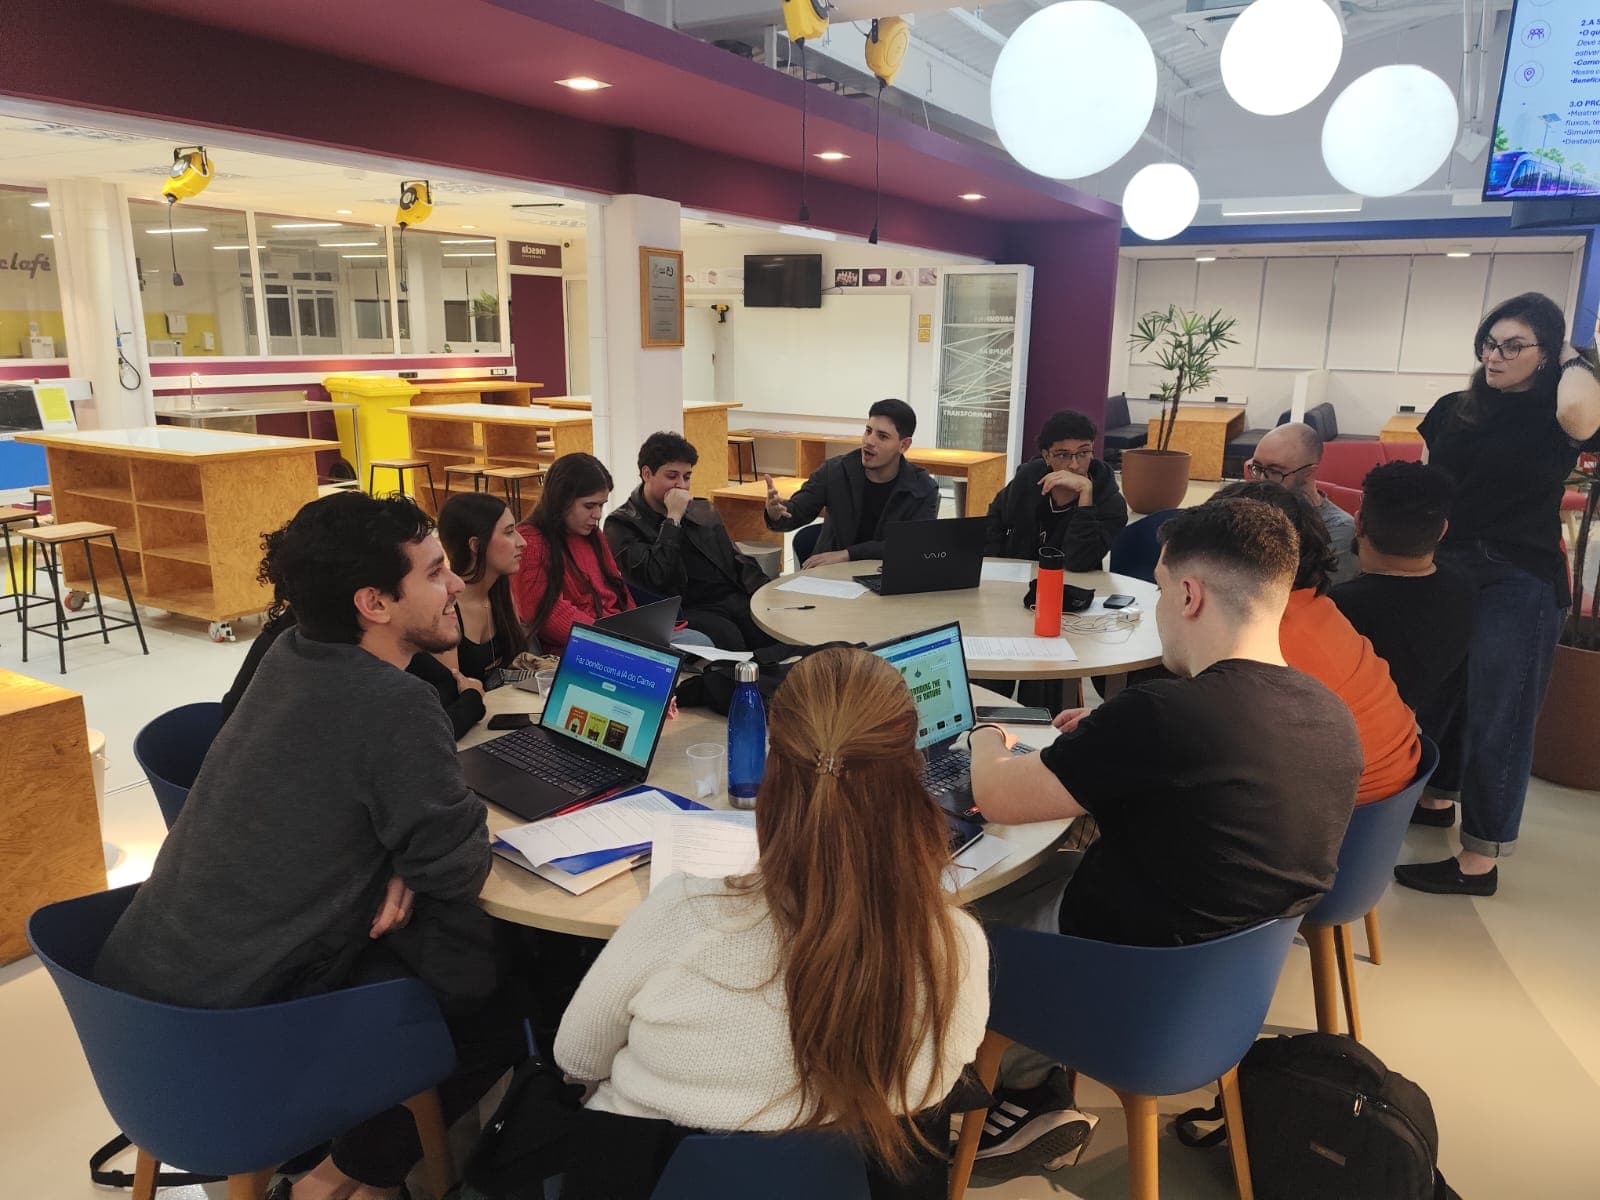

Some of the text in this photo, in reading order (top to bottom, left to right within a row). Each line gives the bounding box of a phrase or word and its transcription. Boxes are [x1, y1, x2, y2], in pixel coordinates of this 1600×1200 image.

[943, 409, 993, 418] TRANSFORMAR
[923, 551, 947, 559] VAIO
[603, 665, 617, 676] com
[627, 672, 637, 682] do
[636, 675, 656, 689] Canva
